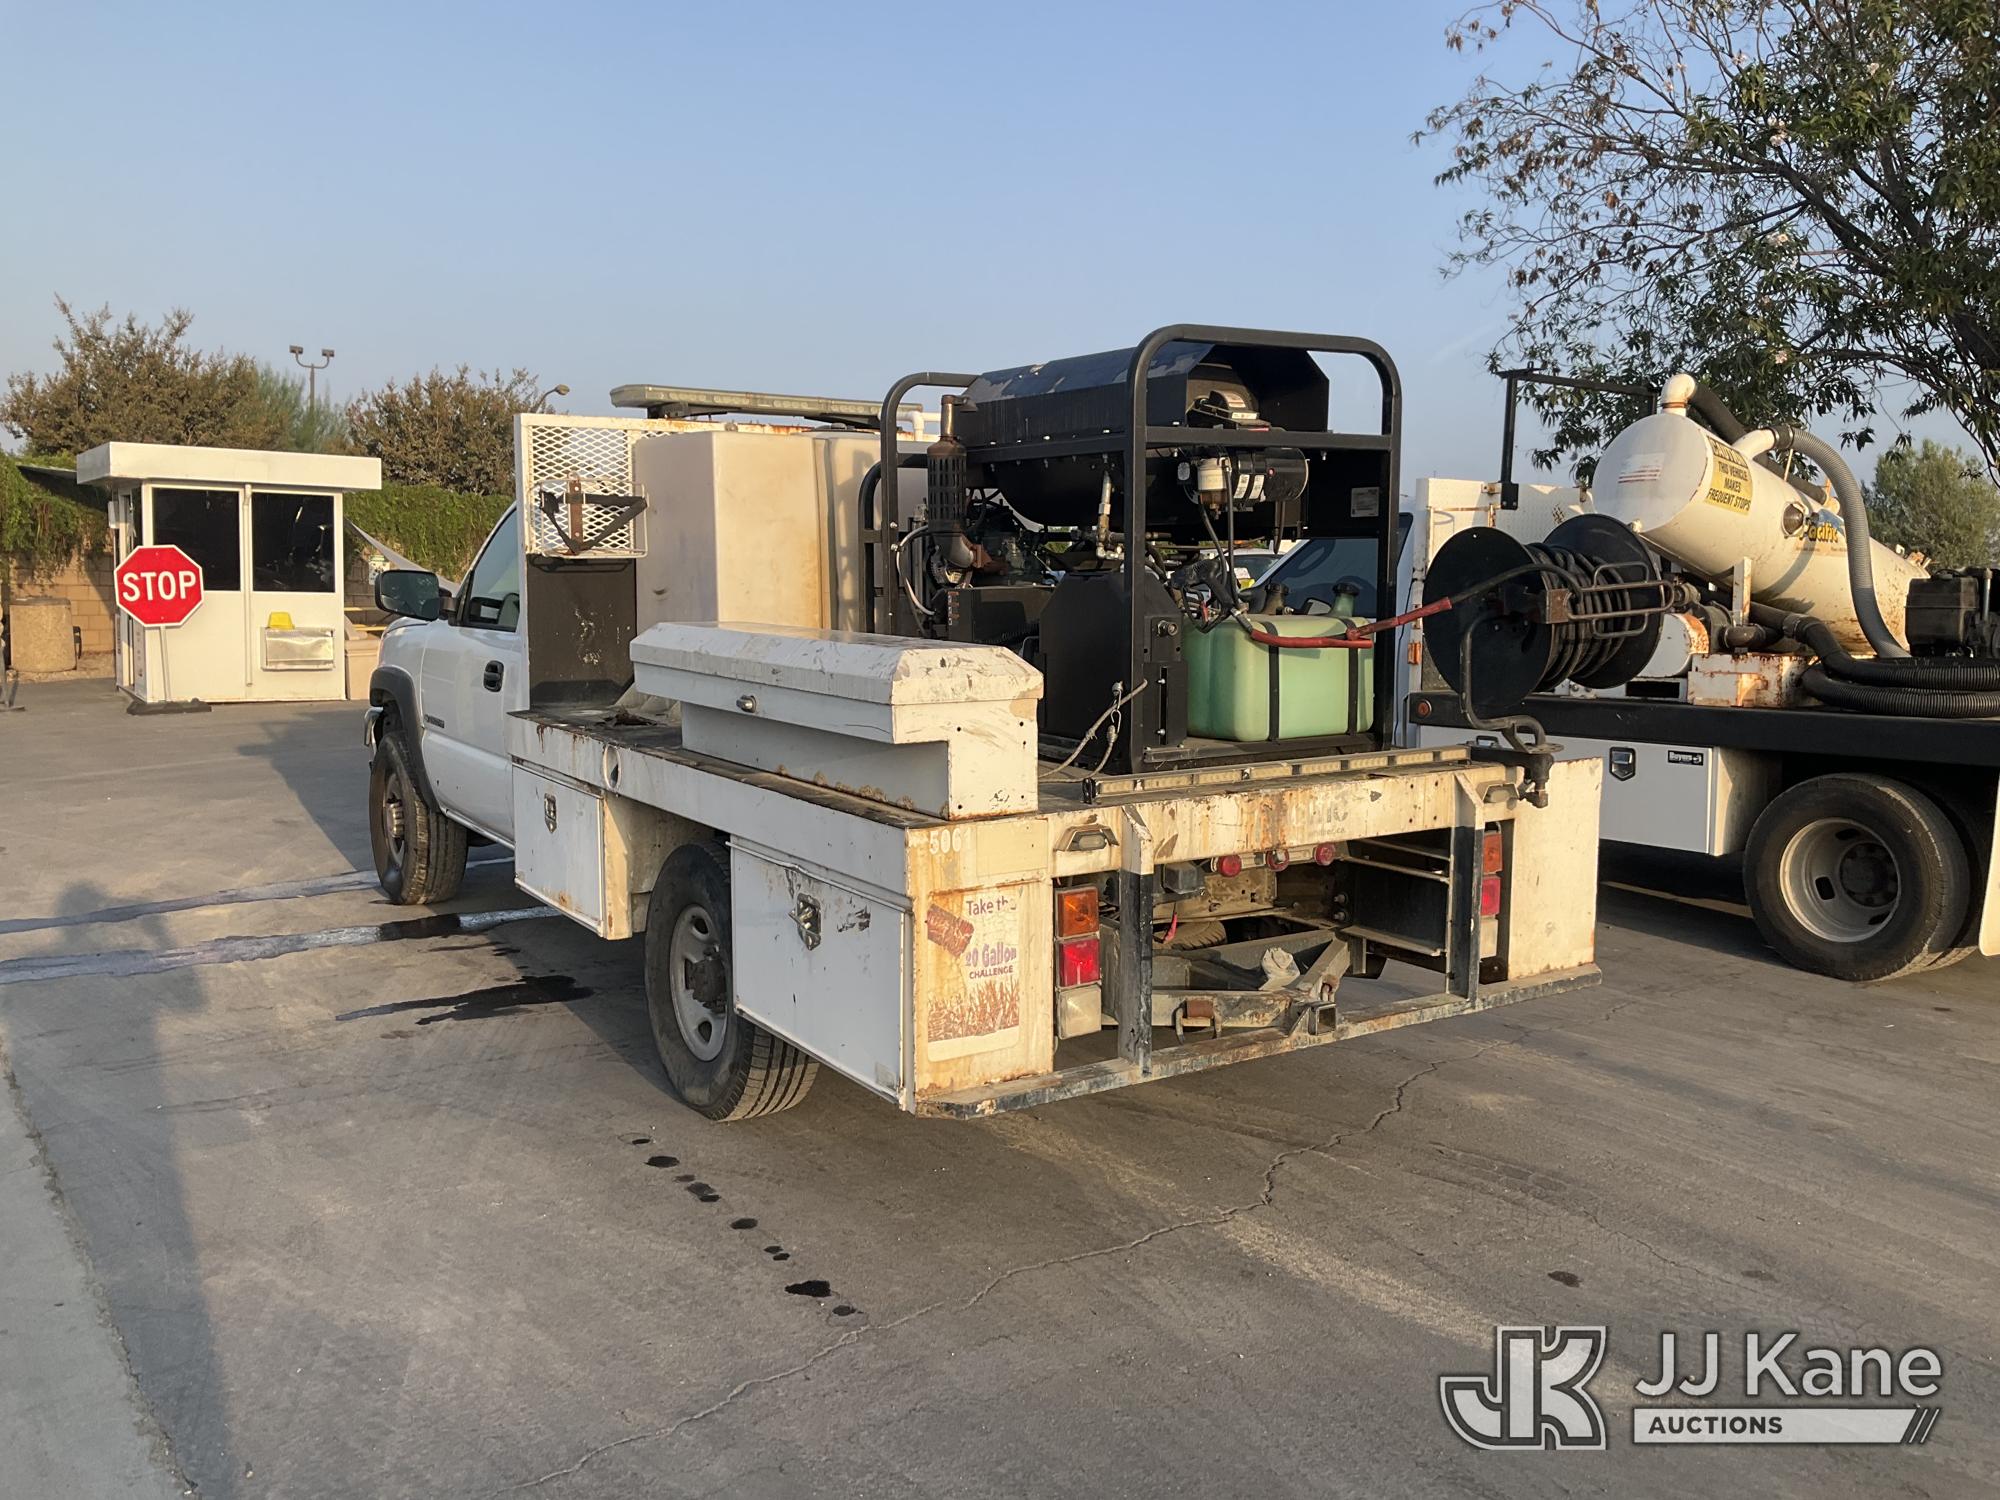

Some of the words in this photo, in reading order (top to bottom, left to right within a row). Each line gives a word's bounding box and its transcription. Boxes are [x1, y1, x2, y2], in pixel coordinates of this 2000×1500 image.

[1718, 461, 1728, 474] THIS
[1730, 465, 1748, 481] VEHICLE
[1724, 478, 1742, 493] MAKES
[1707, 488, 1735, 507] FREQUENT
[1734, 496, 1751, 511] STOPS
[122, 570, 196, 602] STOP
[966, 898, 994, 916] Take
[982, 942, 1016, 967] Gallon
[969, 965, 1013, 979] CHALLENGE
